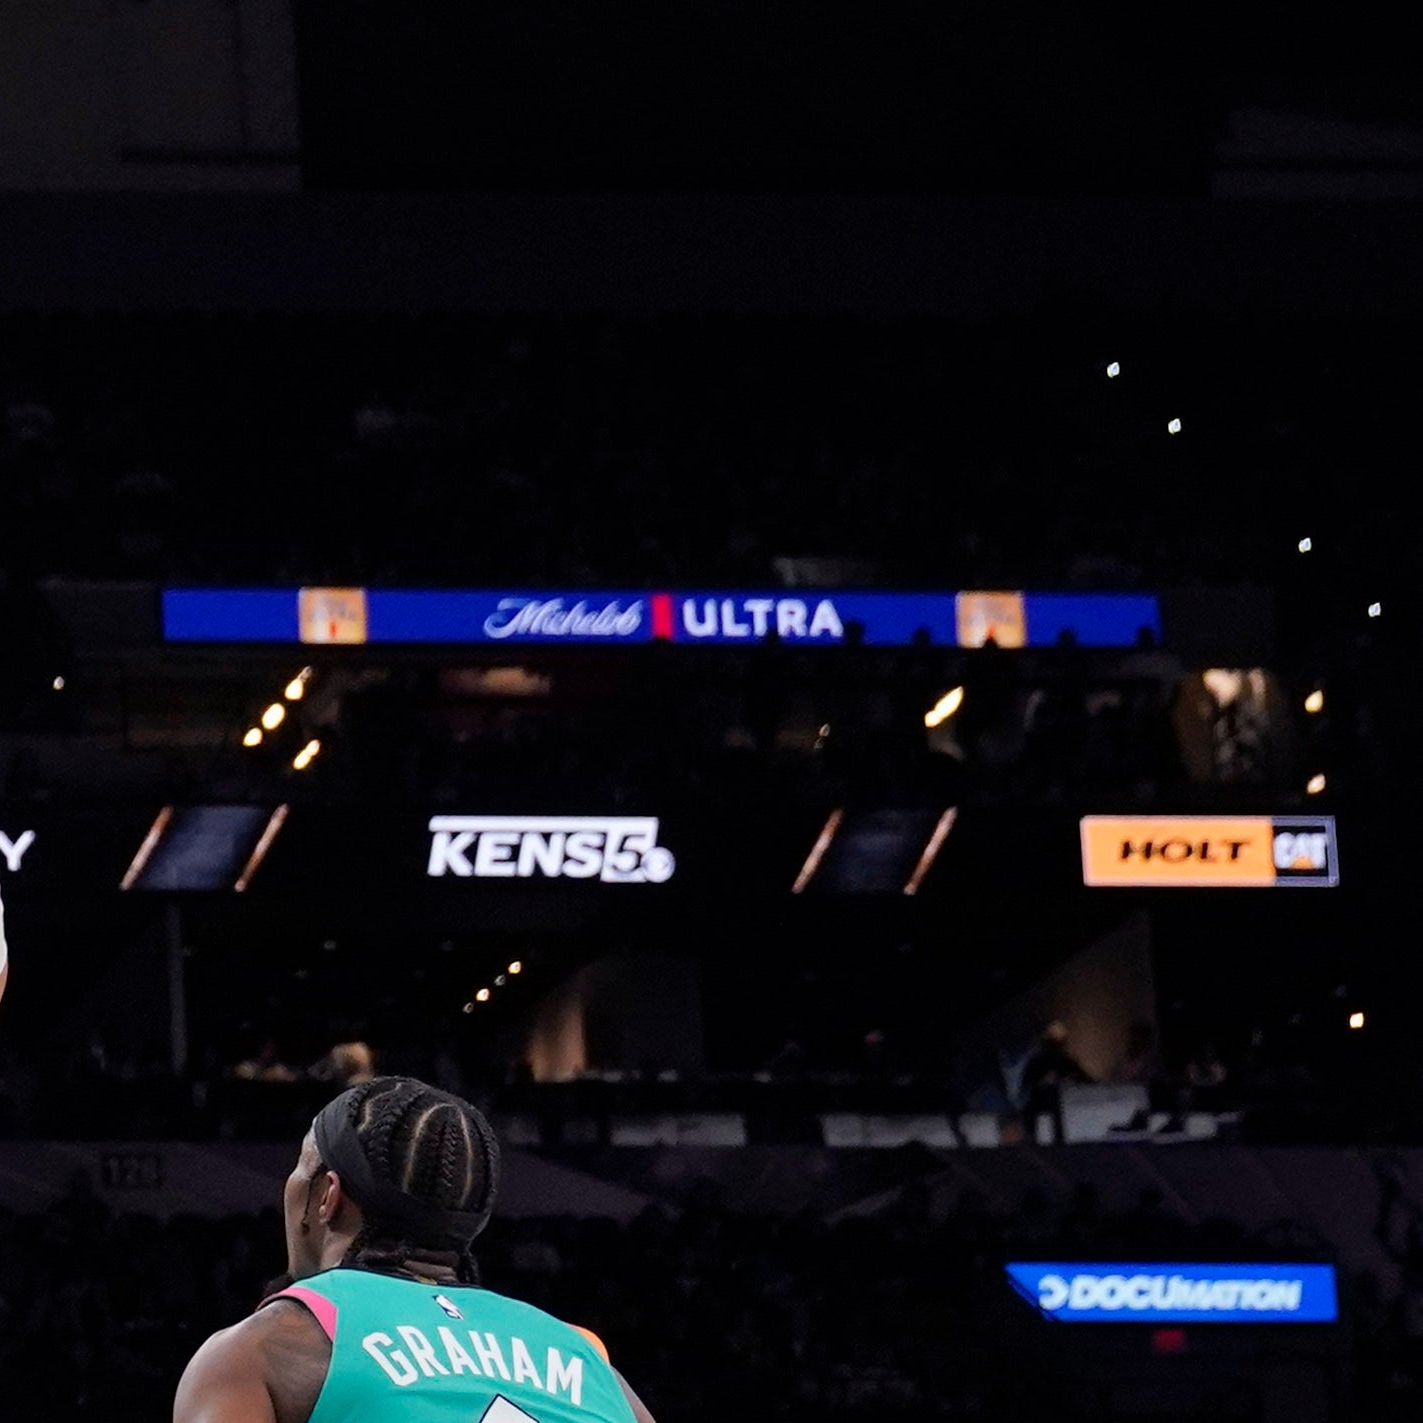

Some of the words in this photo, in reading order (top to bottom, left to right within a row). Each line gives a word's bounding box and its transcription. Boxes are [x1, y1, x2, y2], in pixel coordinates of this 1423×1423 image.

[682, 597, 845, 638] ULTRA
[1117, 839, 1252, 864] HOLT
[361, 1324, 585, 1407] GRAHAM
